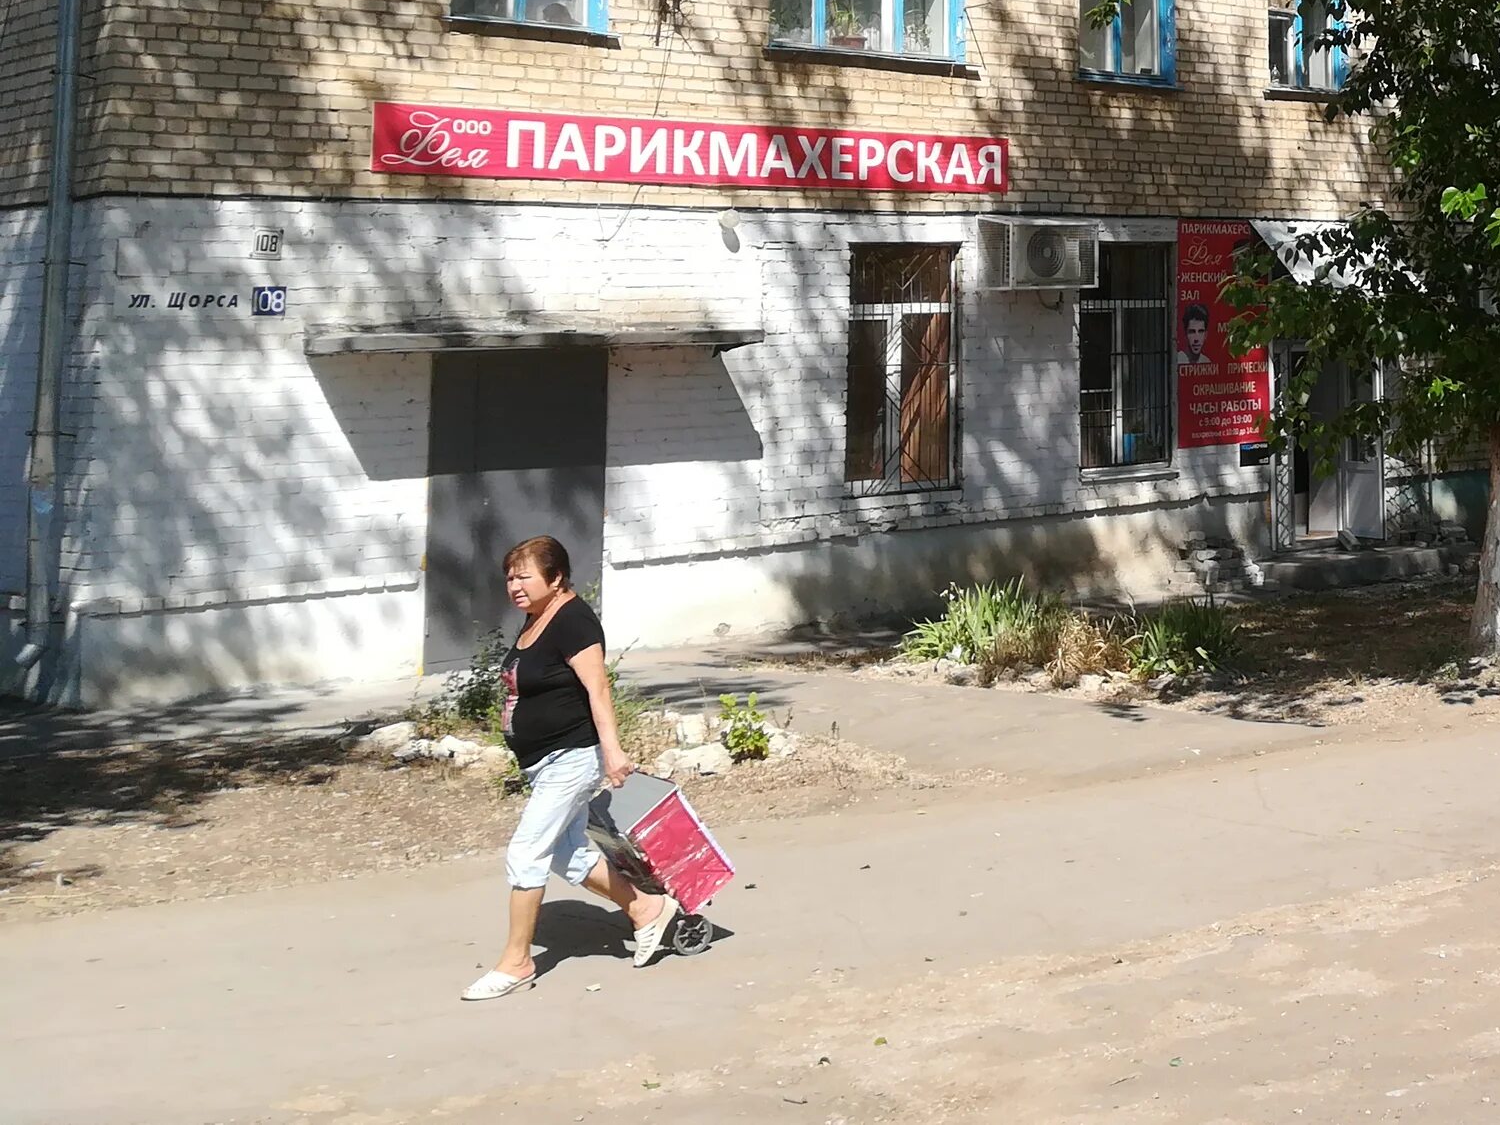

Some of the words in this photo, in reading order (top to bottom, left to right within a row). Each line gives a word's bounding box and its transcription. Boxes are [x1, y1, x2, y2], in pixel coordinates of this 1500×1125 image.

[505, 119, 1004, 185] ПАРИКМАХЕРСКАЯ
[1181, 222, 1251, 235] ПАРИКМАХЕРС
[256, 233, 279, 253] 108
[1180, 270, 1228, 283] ЖЕНСКИЙ
[252, 288, 286, 313] 108
[1180, 290, 1200, 301] ЗАЛ
[1179, 364, 1219, 377] СТРИЖКИ
[1227, 361, 1269, 374] ПРИЧЕСКИ
[1193, 381, 1257, 396] ОКРАШИВАНИЕ
[1189, 402, 1219, 414] ЧАСЫ
[1221, 398, 1261, 413] РАБОТЫ
[1221, 417, 1231, 427] до
[1232, 414, 1252, 424] 19:00
